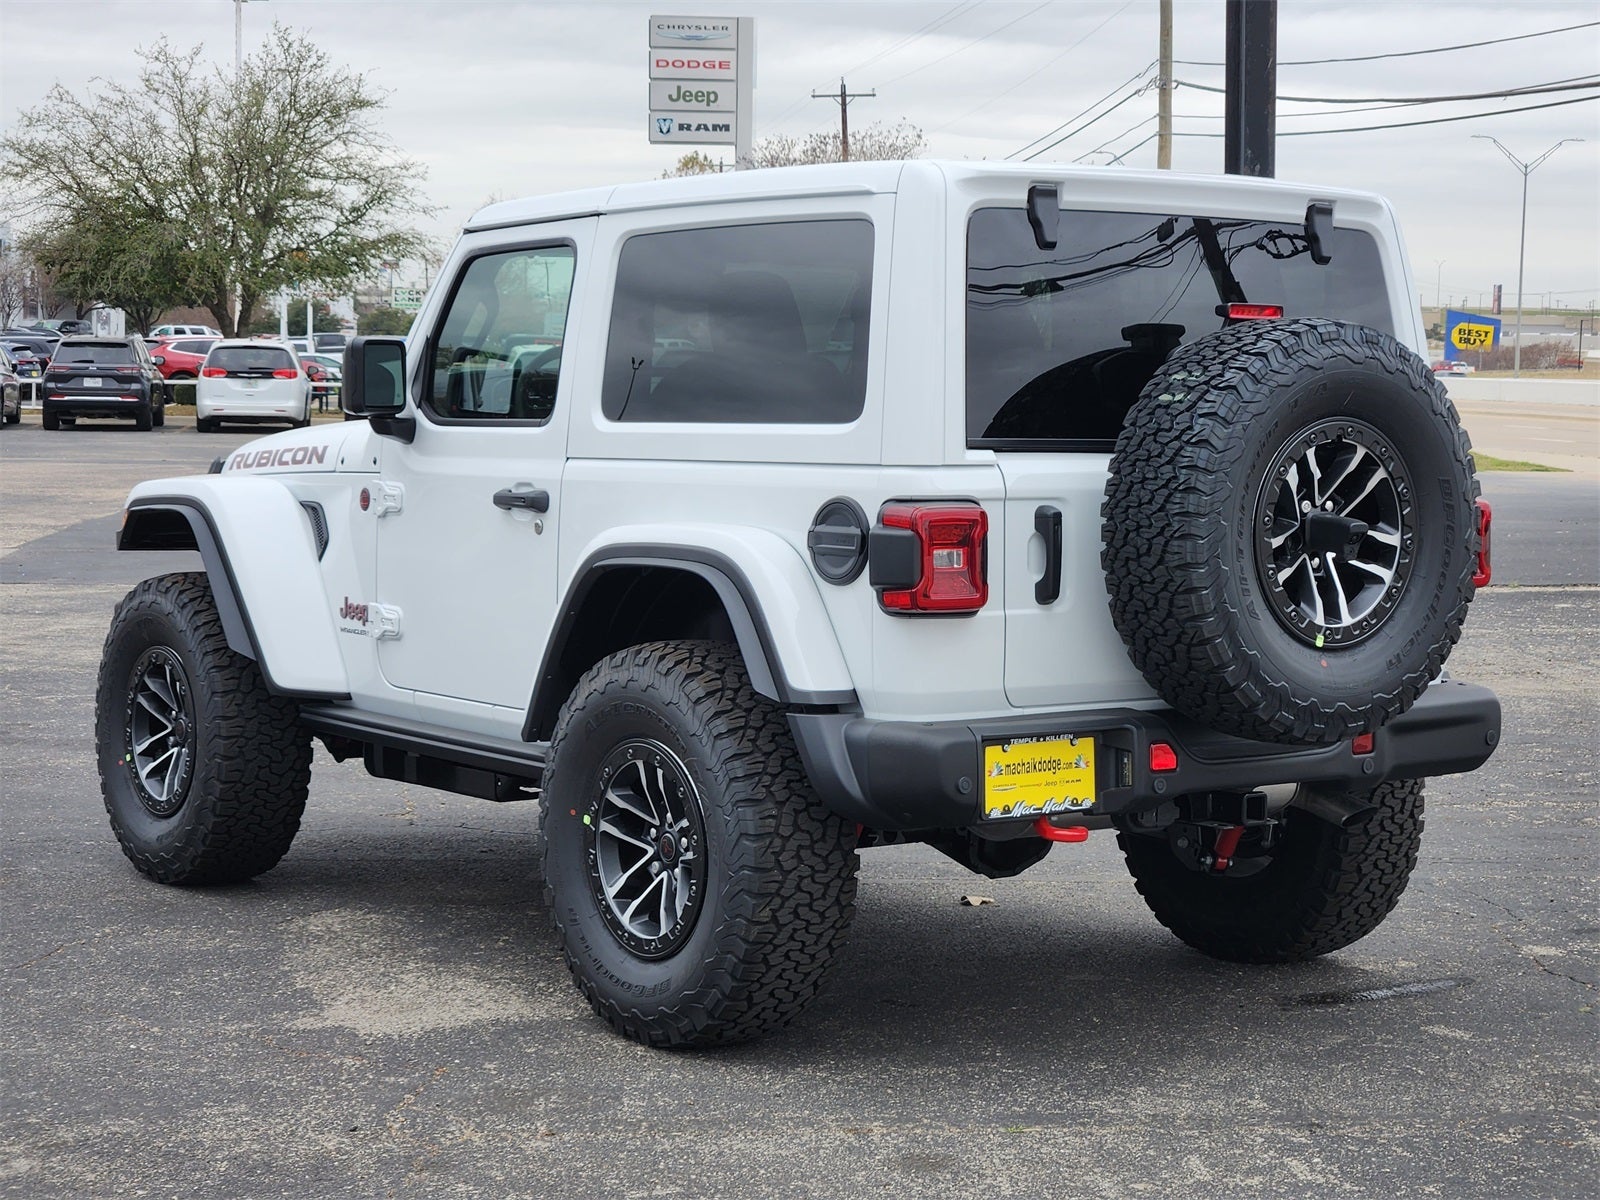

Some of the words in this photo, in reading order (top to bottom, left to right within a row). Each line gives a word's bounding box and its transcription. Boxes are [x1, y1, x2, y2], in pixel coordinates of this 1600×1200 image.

[656, 59, 731, 70] DODGE
[668, 85, 719, 107] Jeep
[678, 123, 730, 132] RAM
[1458, 328, 1490, 338] BEST
[1458, 337, 1486, 345] BUY
[228, 445, 329, 471] RUBICON
[1386, 477, 1456, 671] BFGoodrich
[1010, 736, 1037, 745] TEMPLE
[1045, 734, 1074, 742] KILLEEN
[1004, 757, 1073, 776] machaikdodge.com
[1010, 800, 1041, 818] Mac
[1041, 796, 1073, 814] Haik
